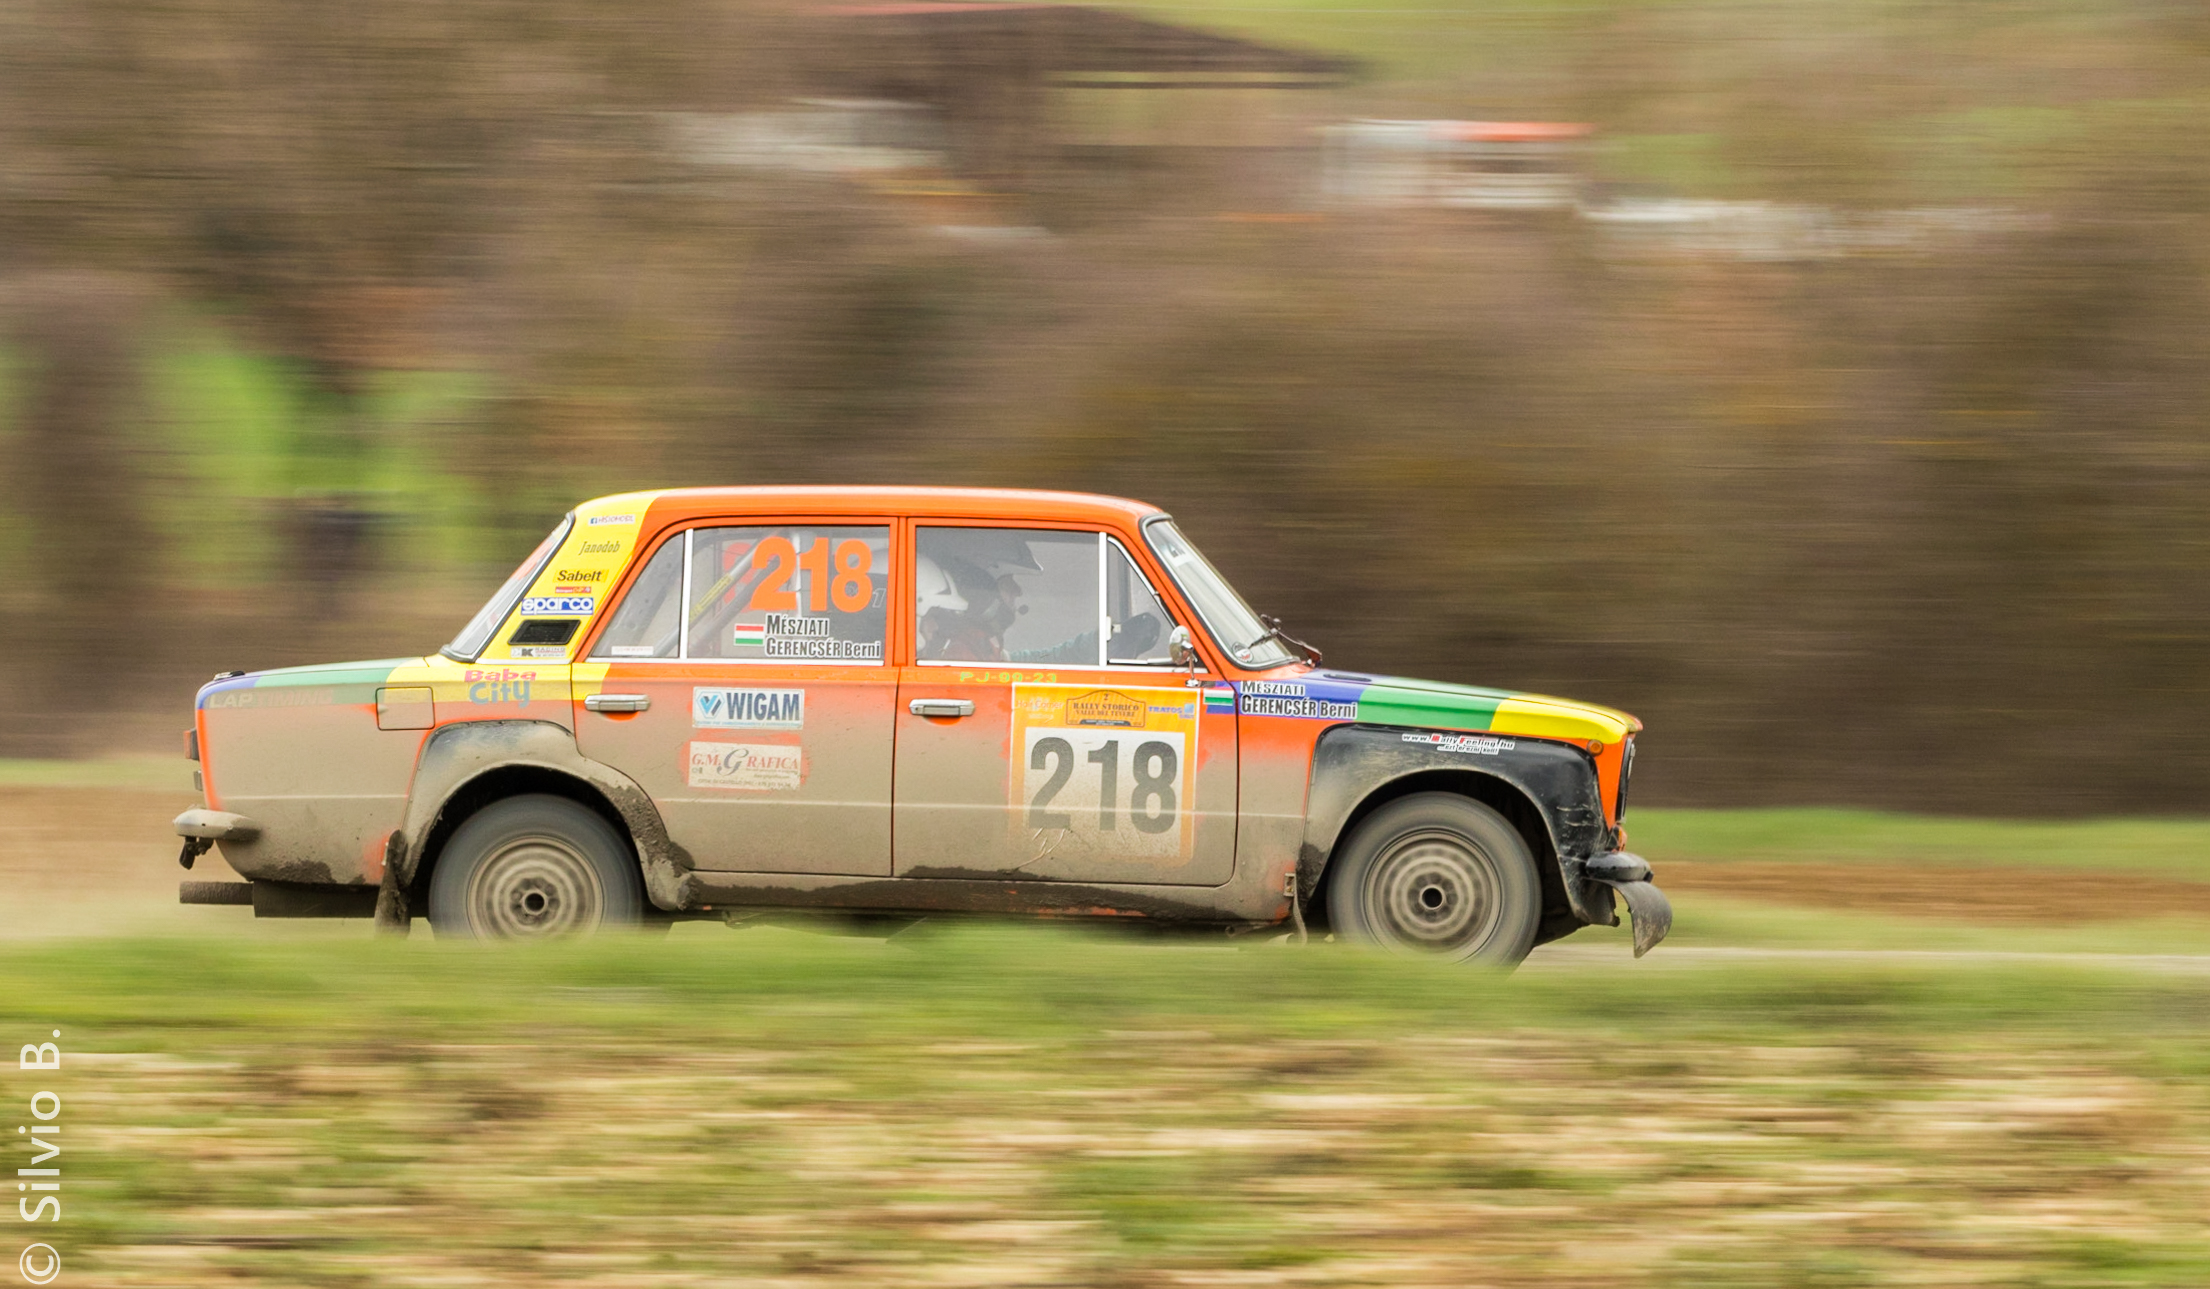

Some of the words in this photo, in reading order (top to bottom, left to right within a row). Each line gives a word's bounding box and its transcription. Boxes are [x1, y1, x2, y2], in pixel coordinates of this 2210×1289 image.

[579, 541, 620, 555] Janodob
[557, 570, 602, 581] Sabelt
[750, 536, 873, 613] 218
[522, 598, 593, 614] sparco
[766, 614, 829, 636] MÉSZIATI
[765, 637, 842, 656] GERENCSÉR
[844, 641, 881, 658] Berni
[464, 669, 537, 682] Baba
[209, 692, 253, 708] LAP
[469, 681, 530, 708] City
[726, 692, 800, 721] WIGAM
[1073, 702, 1099, 710] RALLY
[1102, 704, 1139, 712] STORICO
[1241, 695, 1317, 716] GERENCSÉR
[1320, 702, 1357, 718] Berni
[1029, 737, 1177, 834] 218
